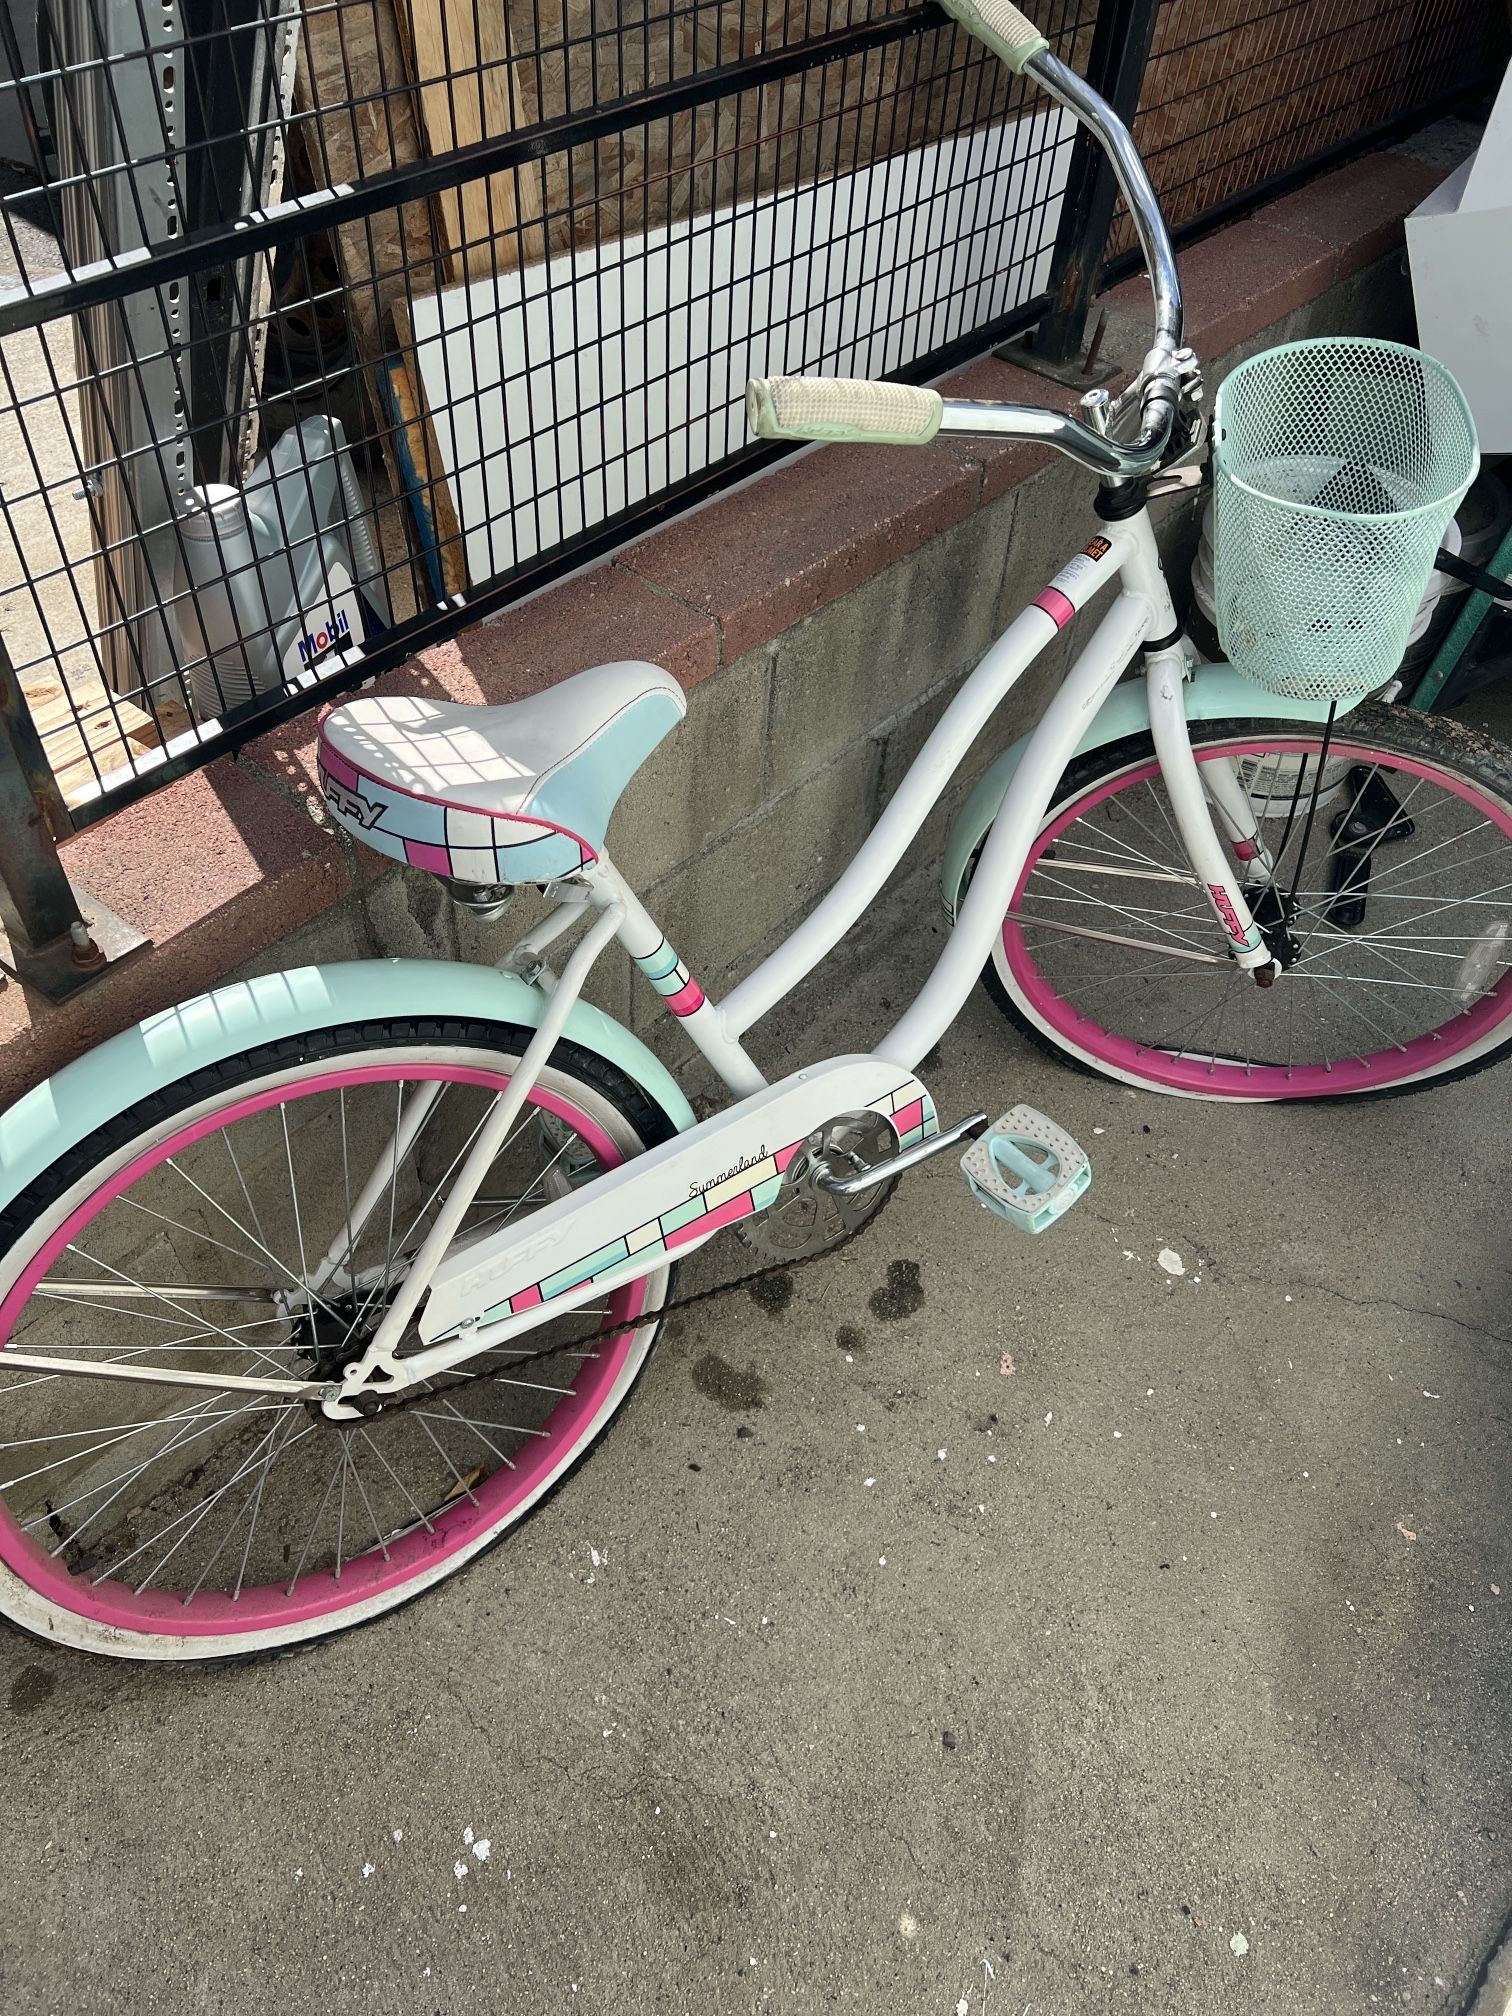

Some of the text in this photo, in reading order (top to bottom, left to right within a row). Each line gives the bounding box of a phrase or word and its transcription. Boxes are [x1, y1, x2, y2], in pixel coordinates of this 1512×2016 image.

[297, 609, 349, 662] Mobil
[318, 763, 389, 831] FFY
[1206, 883, 1250, 948] HUFFY
[689, 1144, 769, 1198] Summerland
